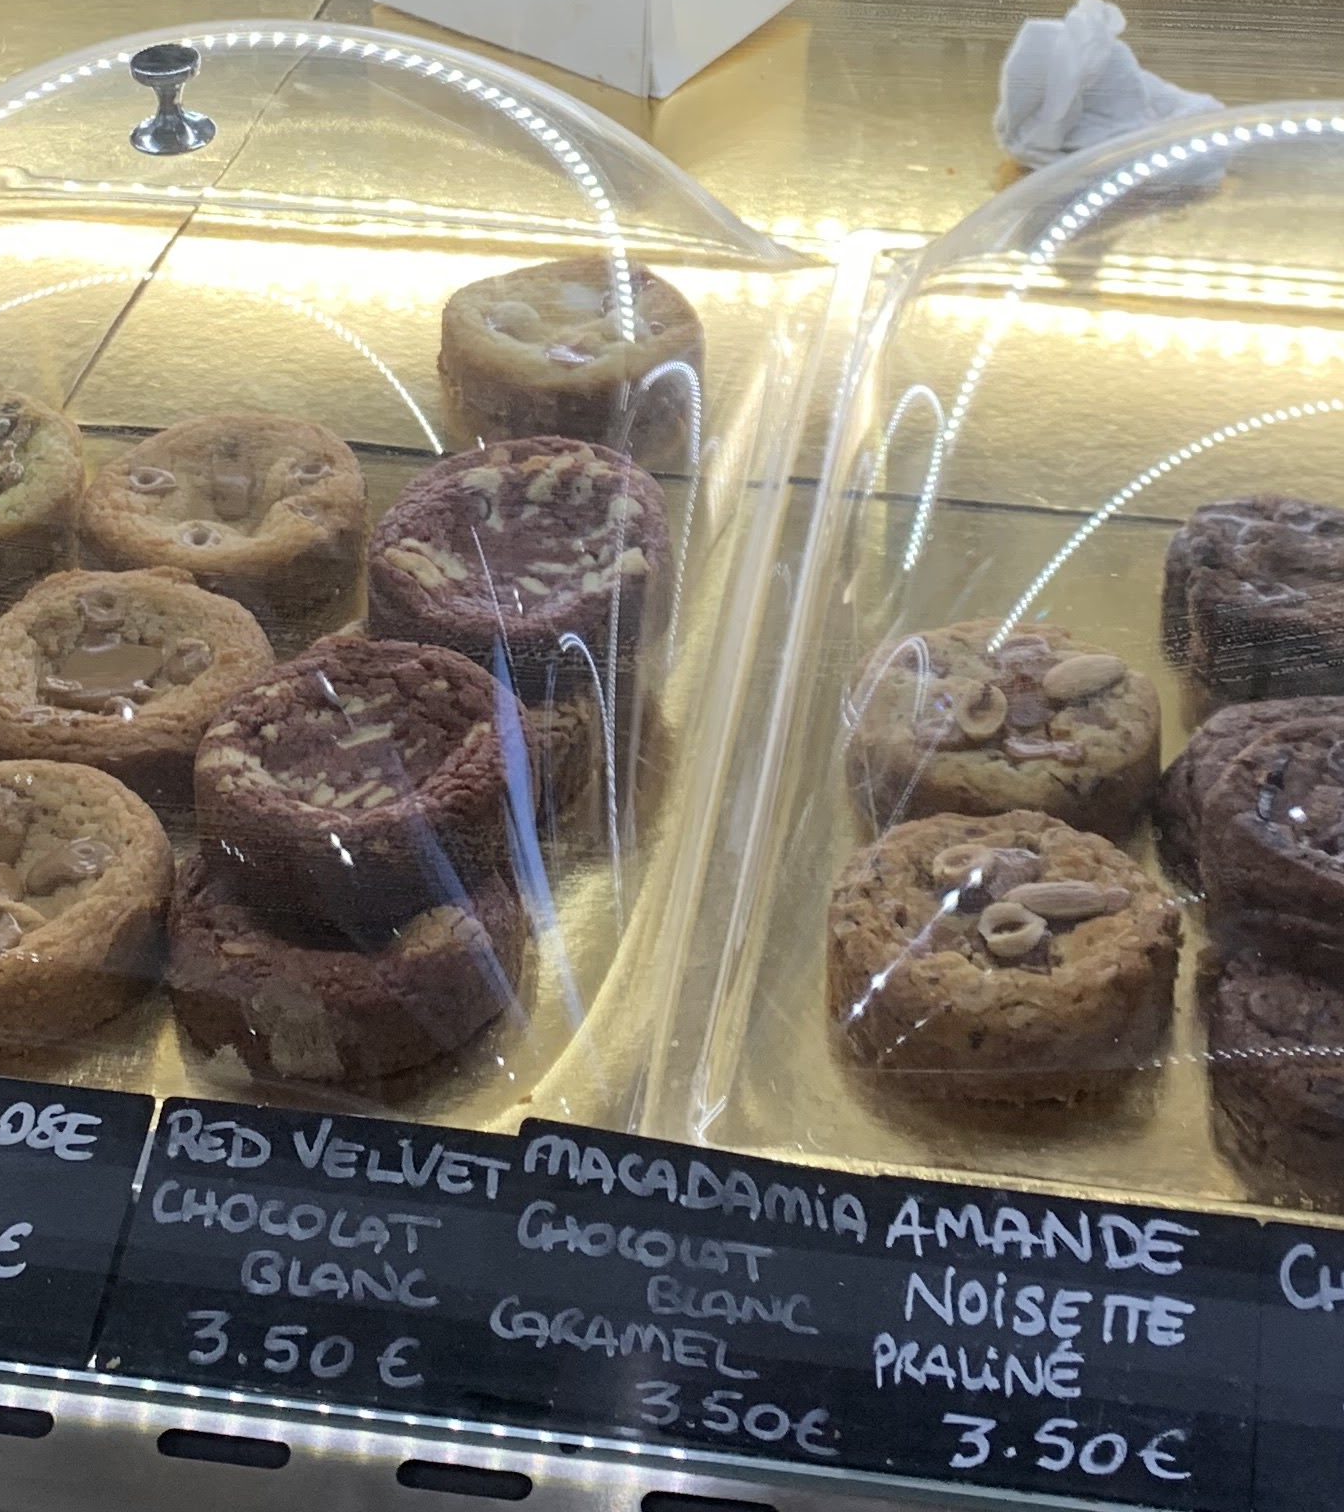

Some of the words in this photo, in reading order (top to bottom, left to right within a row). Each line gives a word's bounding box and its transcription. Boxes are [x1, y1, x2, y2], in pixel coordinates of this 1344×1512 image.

[167, 1109, 271, 1167] RED
[293, 1118, 510, 1199] VELVET
[152, 1180, 442, 1253] CHOCOLAT
[517, 1199, 774, 1282] CHOCOLAT
[886, 1197, 1199, 1275] AMANDE
[241, 1250, 439, 1308] BLANC
[489, 1295, 759, 1379] CARAMEL
